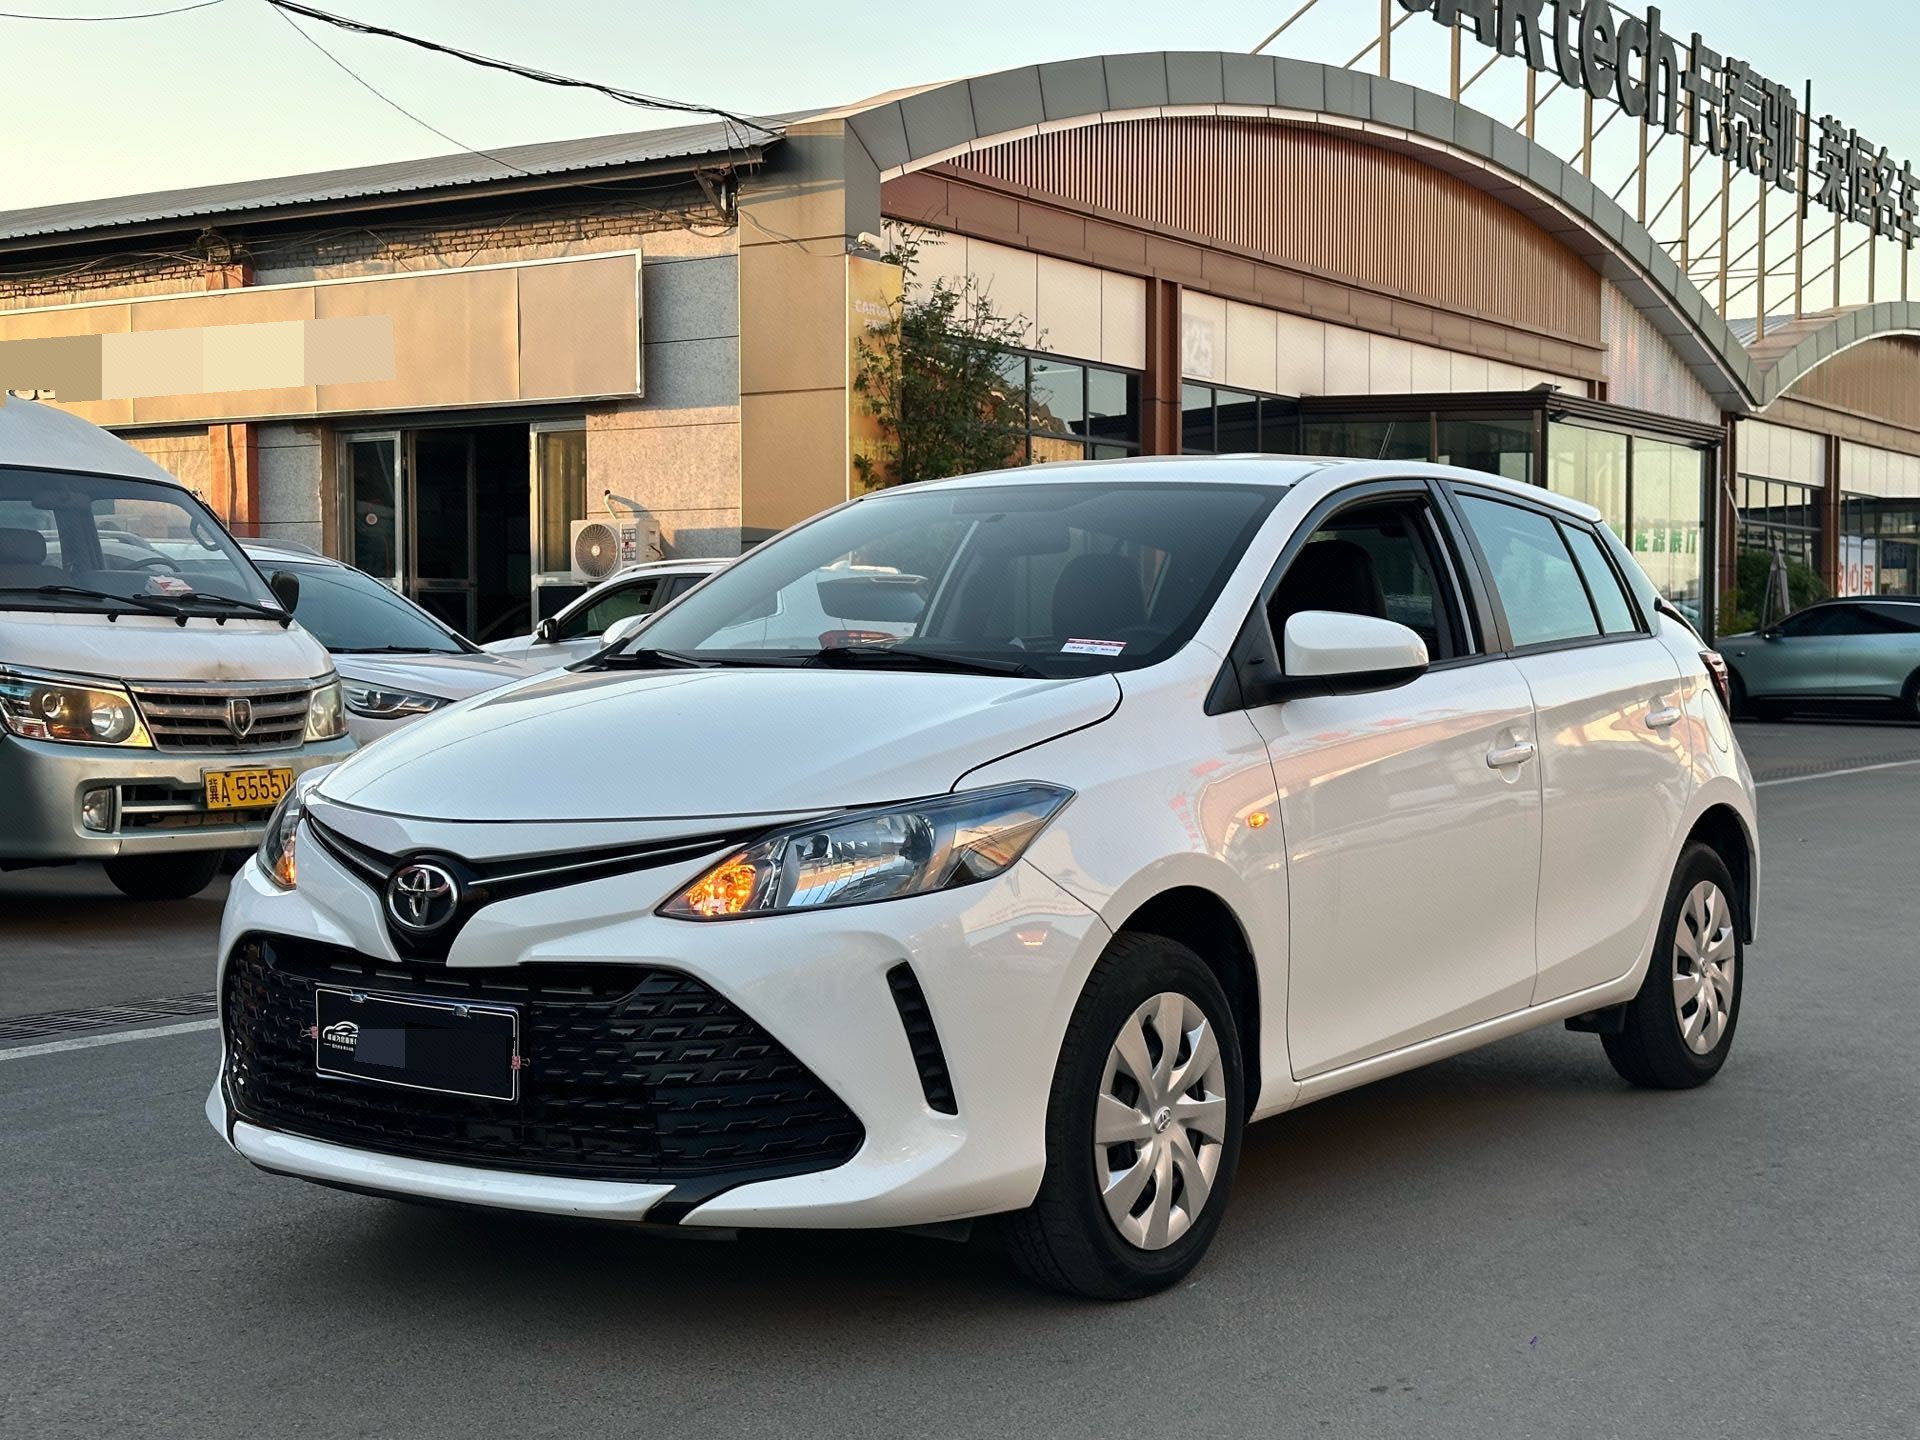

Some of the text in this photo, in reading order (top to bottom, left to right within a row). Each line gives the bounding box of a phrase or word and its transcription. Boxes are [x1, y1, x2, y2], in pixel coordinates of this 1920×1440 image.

[1397, 0, 1678, 135] Rtech
[1681, 32, 1797, 193] 卡泰驰
